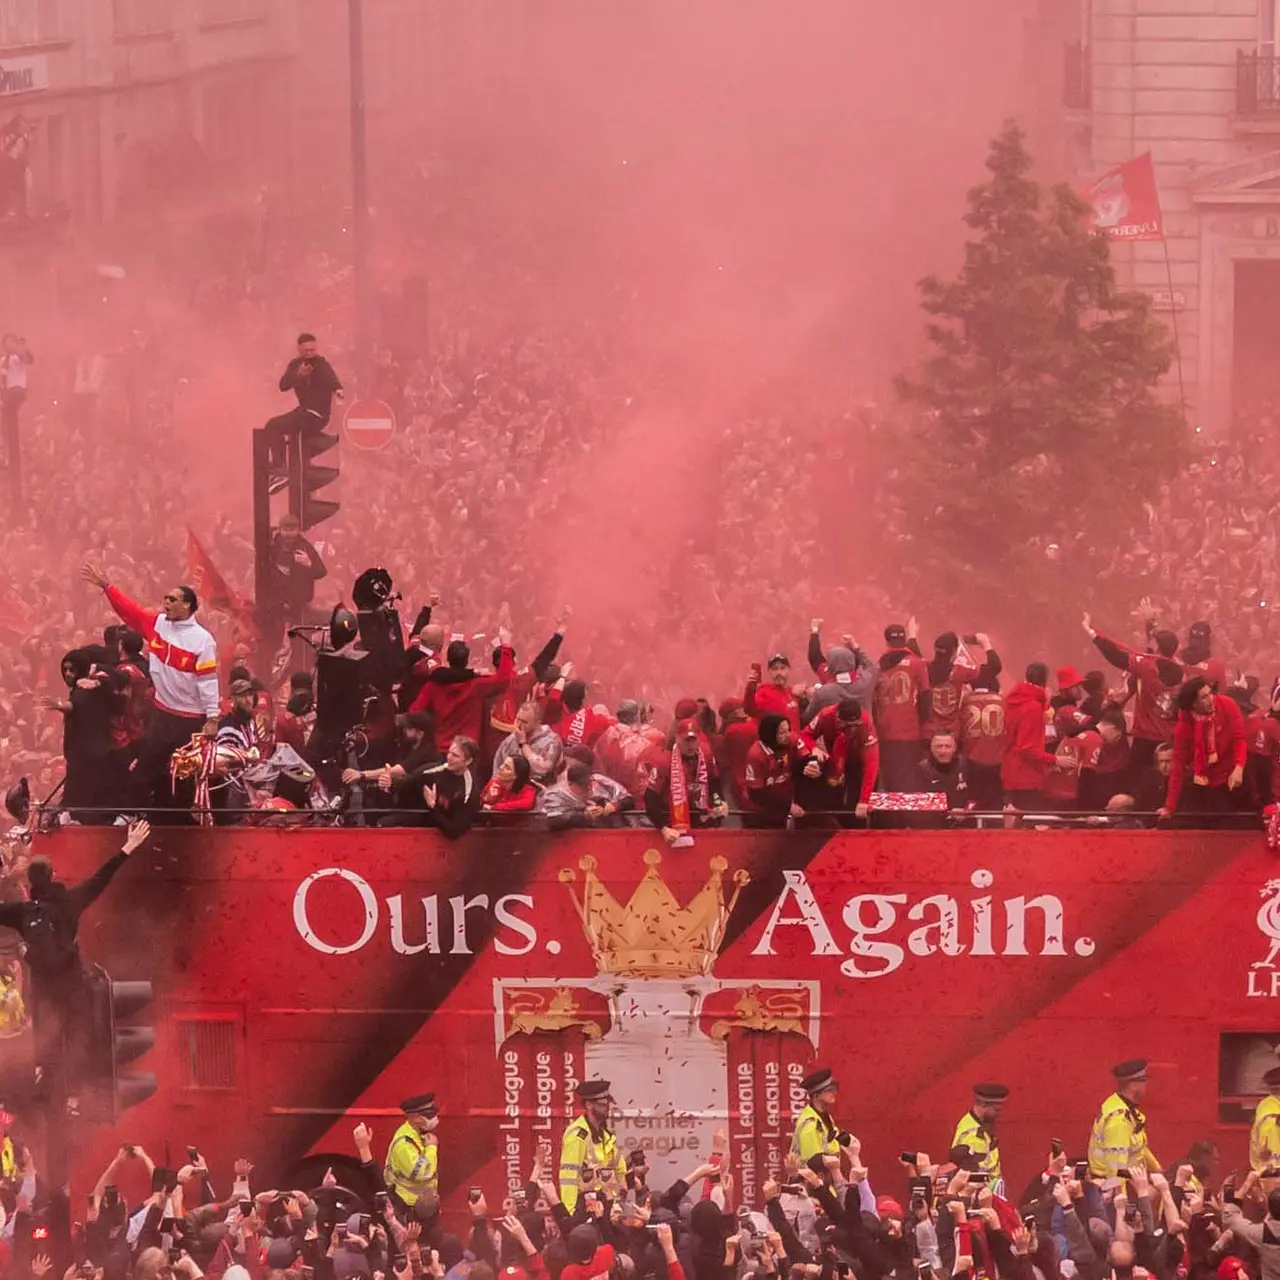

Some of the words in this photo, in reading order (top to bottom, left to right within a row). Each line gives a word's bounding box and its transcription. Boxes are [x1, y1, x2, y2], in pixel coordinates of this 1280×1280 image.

[966, 704, 1004, 737] 20
[292, 867, 562, 957] Ours.
[750, 868, 1096, 978] Again.
[500, 1050, 524, 1130] League
[532, 1051, 556, 1130] League
[611, 1108, 696, 1129] Premier
[733, 1063, 755, 1139] League
[762, 1062, 780, 1138] League
